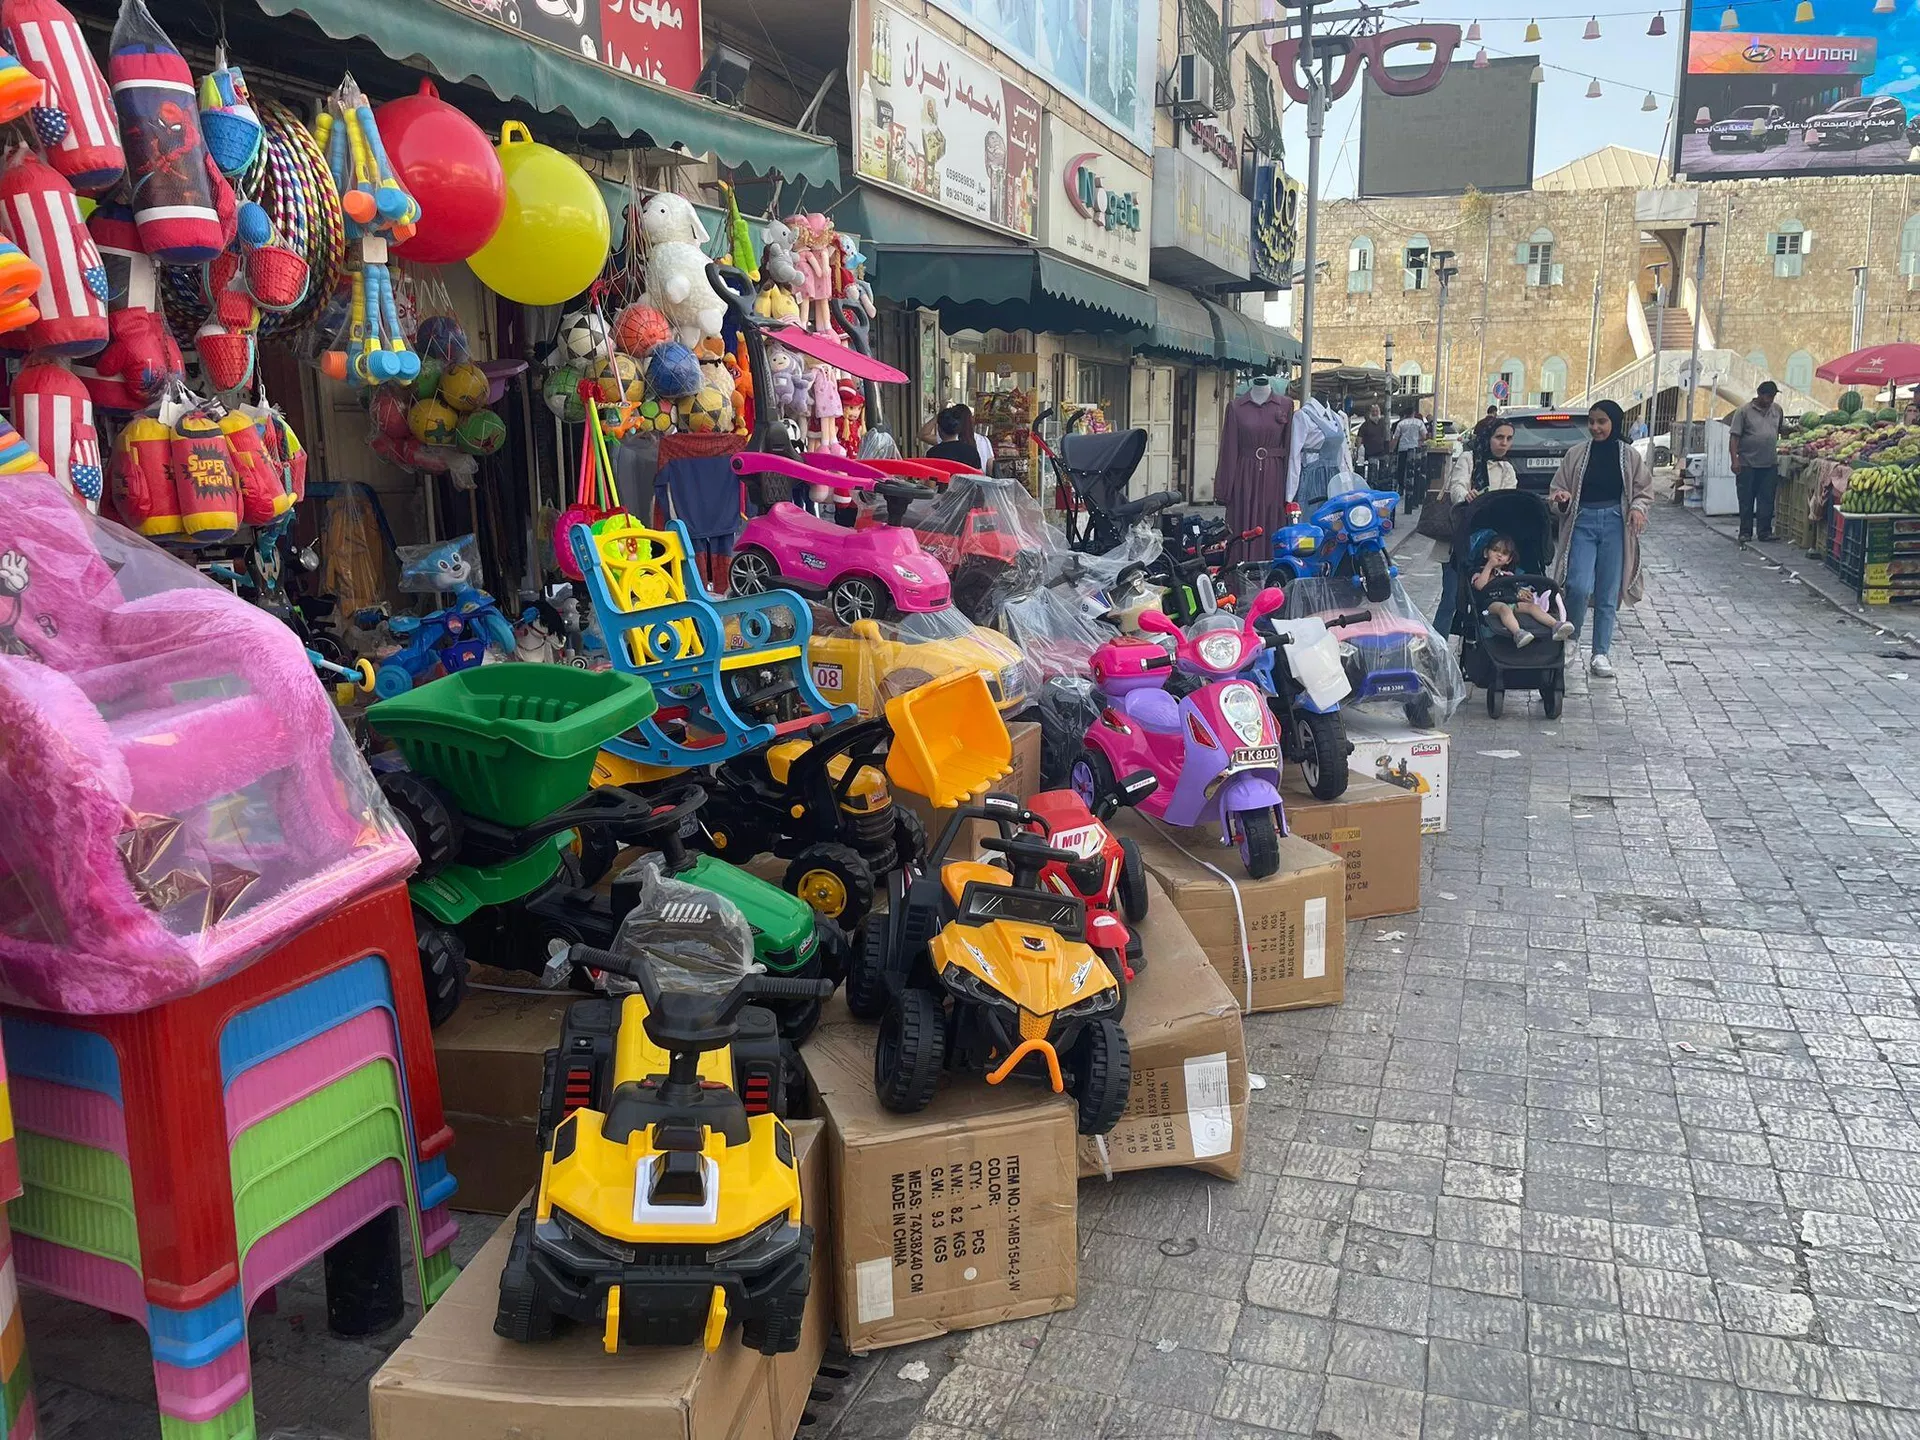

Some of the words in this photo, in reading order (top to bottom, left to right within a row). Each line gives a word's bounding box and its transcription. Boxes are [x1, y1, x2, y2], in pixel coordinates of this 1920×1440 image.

[1780, 47, 1857, 62] HYUNDAI
[904, 35, 951, 109] زهران
[955, 76, 1001, 125] محمد
[187, 454, 227, 474] SUPER
[817, 669, 838, 688] 08
[1239, 748, 1276, 761] TK800
[1346, 850, 1361, 858] PCS
[1346, 861, 1362, 869] KGS
[1346, 872, 1361, 881] KGS
[1357, 881, 1368, 890] CM
[1160, 1081, 1170, 1110] CHINA
[1150, 1119, 1163, 1152] MEAS:
[1163, 1121, 1176, 1150] MADE
[950, 1163, 963, 1195] N.W.:
[969, 1160, 982, 1190] QTY:
[988, 1157, 1001, 1206] COLOR:
[1006, 1154, 1019, 1184] ITEM
[891, 1173, 905, 1210] MADE
[908, 1170, 922, 1210] MEAS:
[931, 1167, 944, 1199] G.W.:
[970, 1203, 982, 1211] 1
[1007, 1186, 1020, 1213] NO.:
[893, 1212, 906, 1226] IN
[932, 1211, 945, 1229] 9.3
[951, 1206, 963, 1224] 8.2
[893, 1228, 907, 1267] CHINA
[909, 1214, 923, 1271] 74X38X40
[934, 1235, 948, 1263] KGS
[953, 1231, 966, 1258] KGS
[972, 1230, 985, 1255] PCS
[1008, 1215, 1021, 1291] Y-MB154-2-W
[911, 1274, 923, 1293] CM
